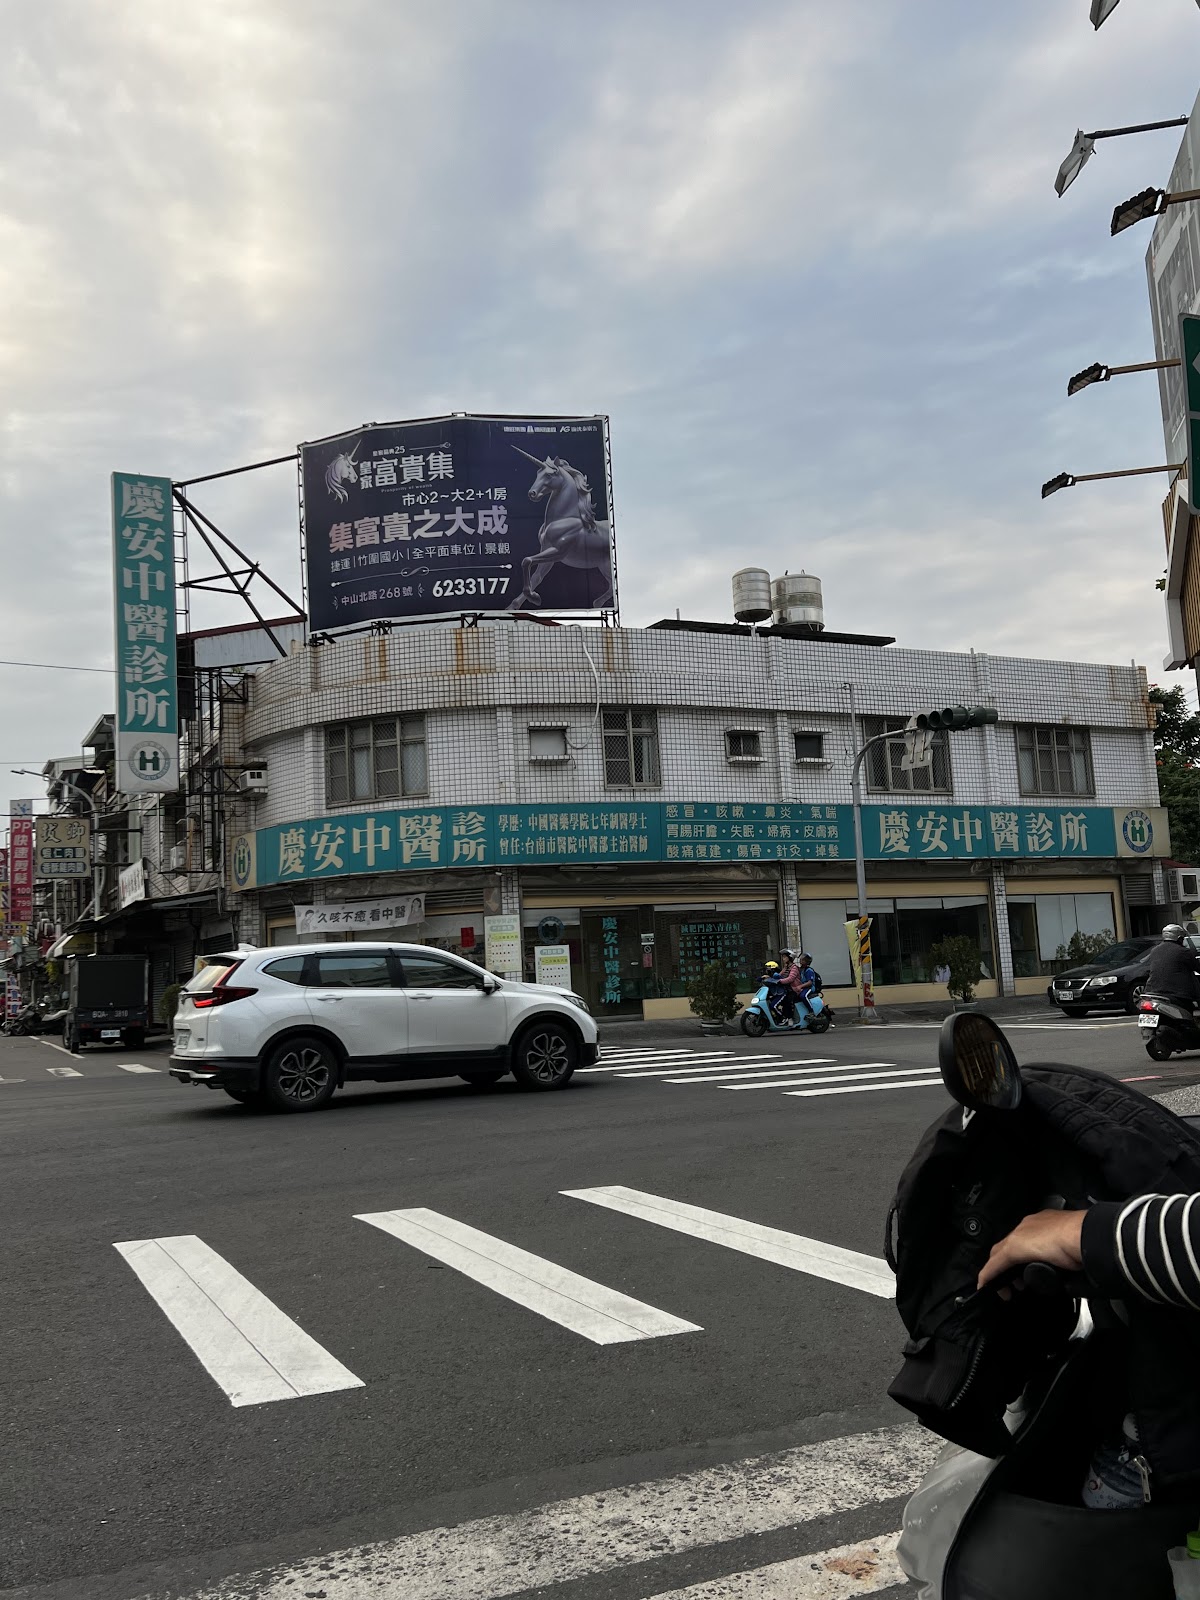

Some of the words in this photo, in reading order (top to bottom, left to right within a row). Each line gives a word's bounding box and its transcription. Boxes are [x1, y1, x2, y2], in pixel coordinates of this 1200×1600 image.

[360, 461, 373, 490] 皇家
[373, 451, 455, 487] 富貴集
[328, 504, 509, 554] 集富貴之大成
[120, 480, 171, 729] 慶安中醫診所
[432, 577, 511, 598] 6233177
[878, 810, 1088, 853] 慶安中醫診所
[601, 916, 621, 1004] 慶安中醫診所
